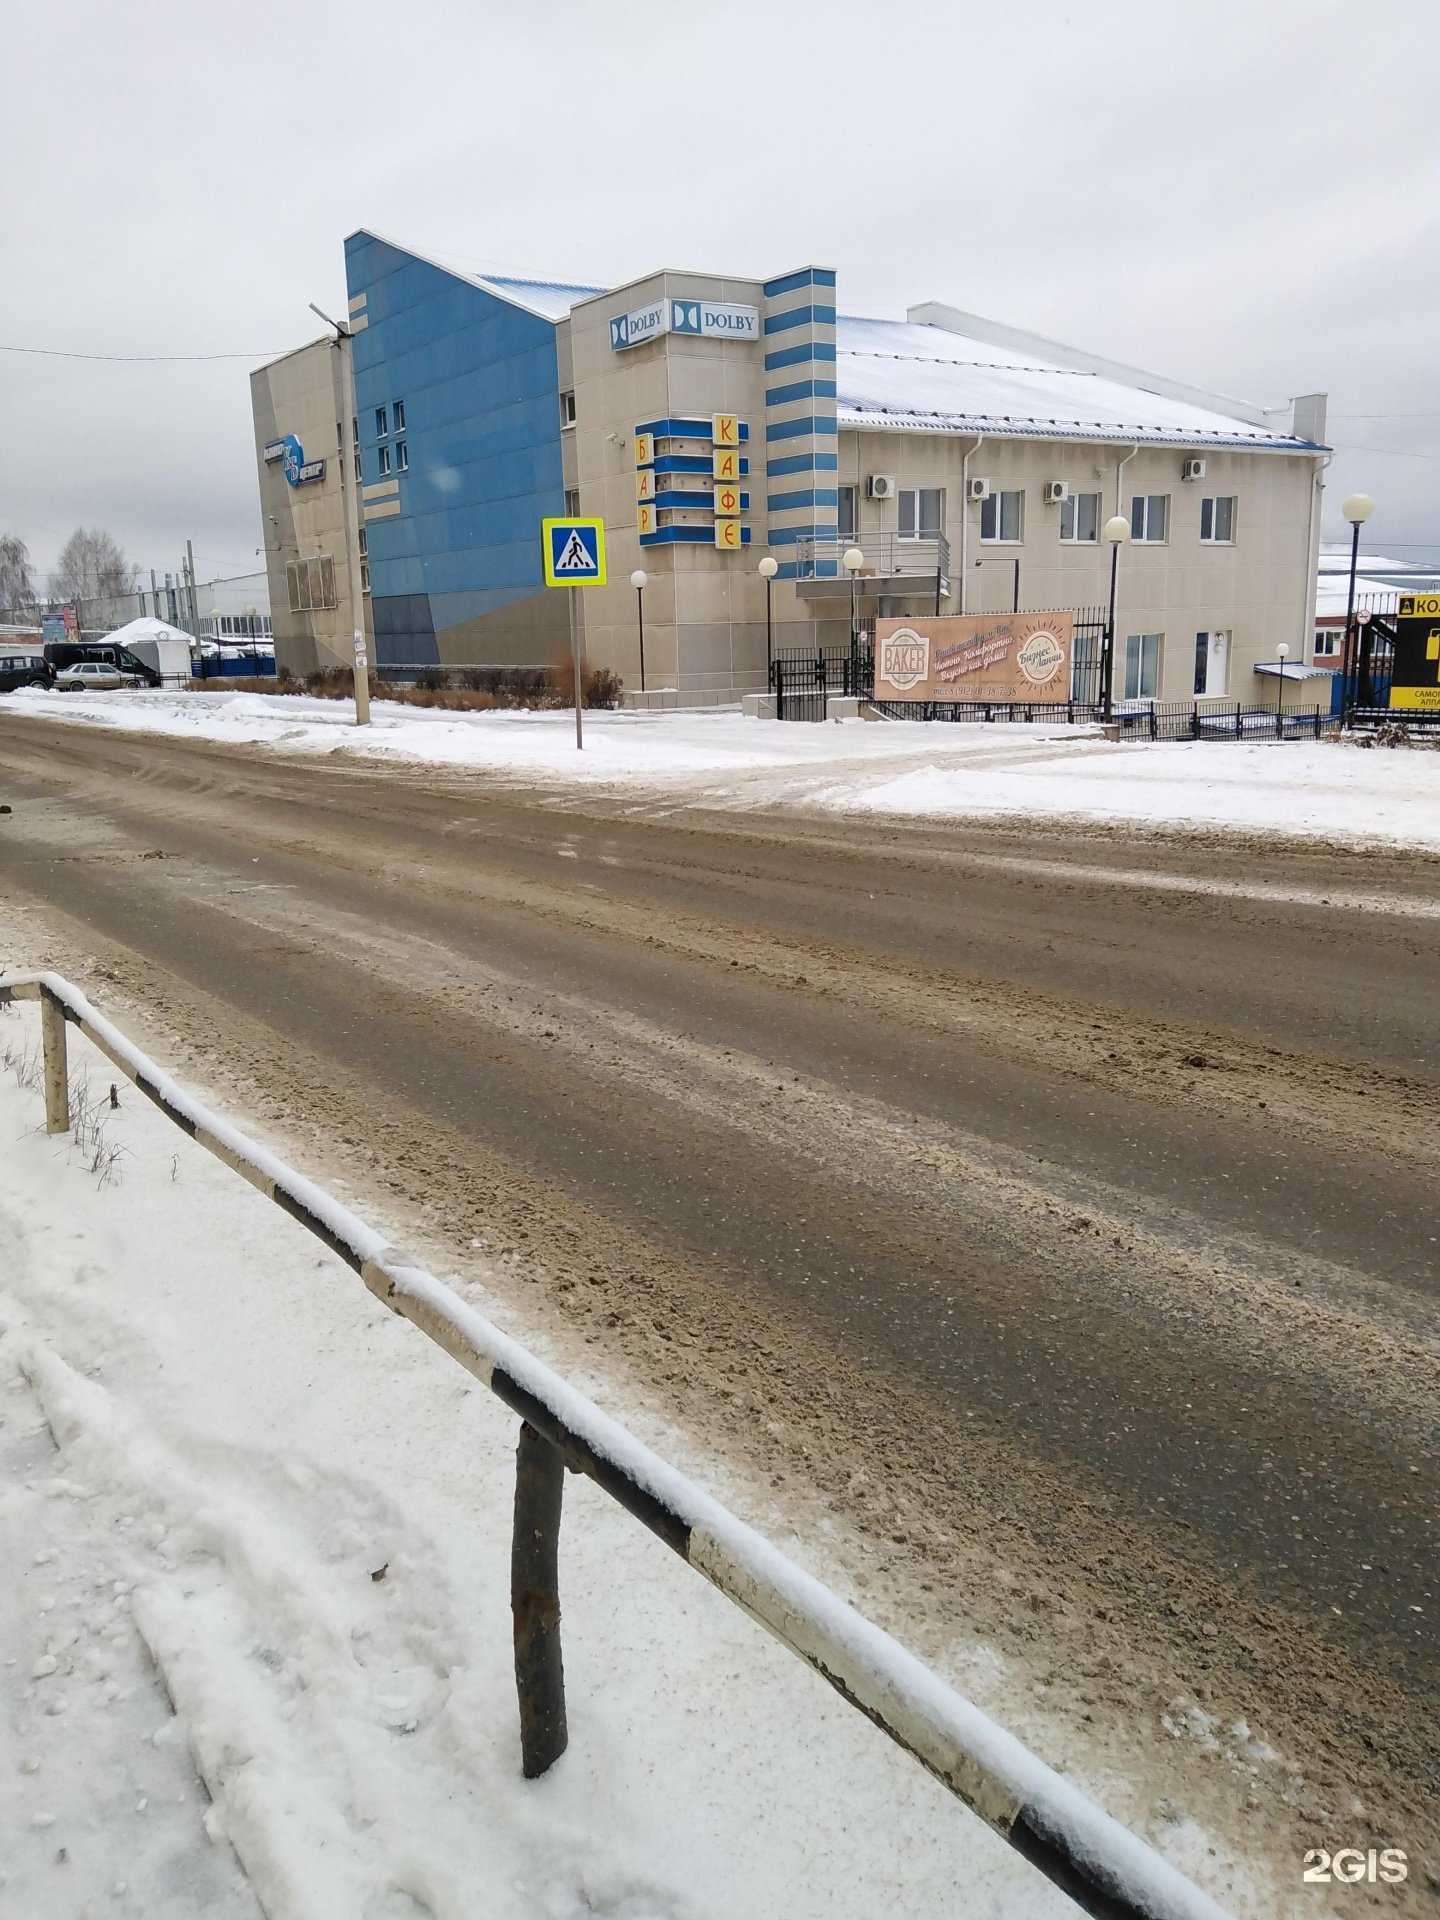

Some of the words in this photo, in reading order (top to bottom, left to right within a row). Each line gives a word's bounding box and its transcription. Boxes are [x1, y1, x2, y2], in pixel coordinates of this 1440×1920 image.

[630, 310, 662, 334] DOLBY
[705, 313, 754, 330] DOLBY
[1417, 600, 1440, 612] КО
[885, 646, 925, 671] BAKER
